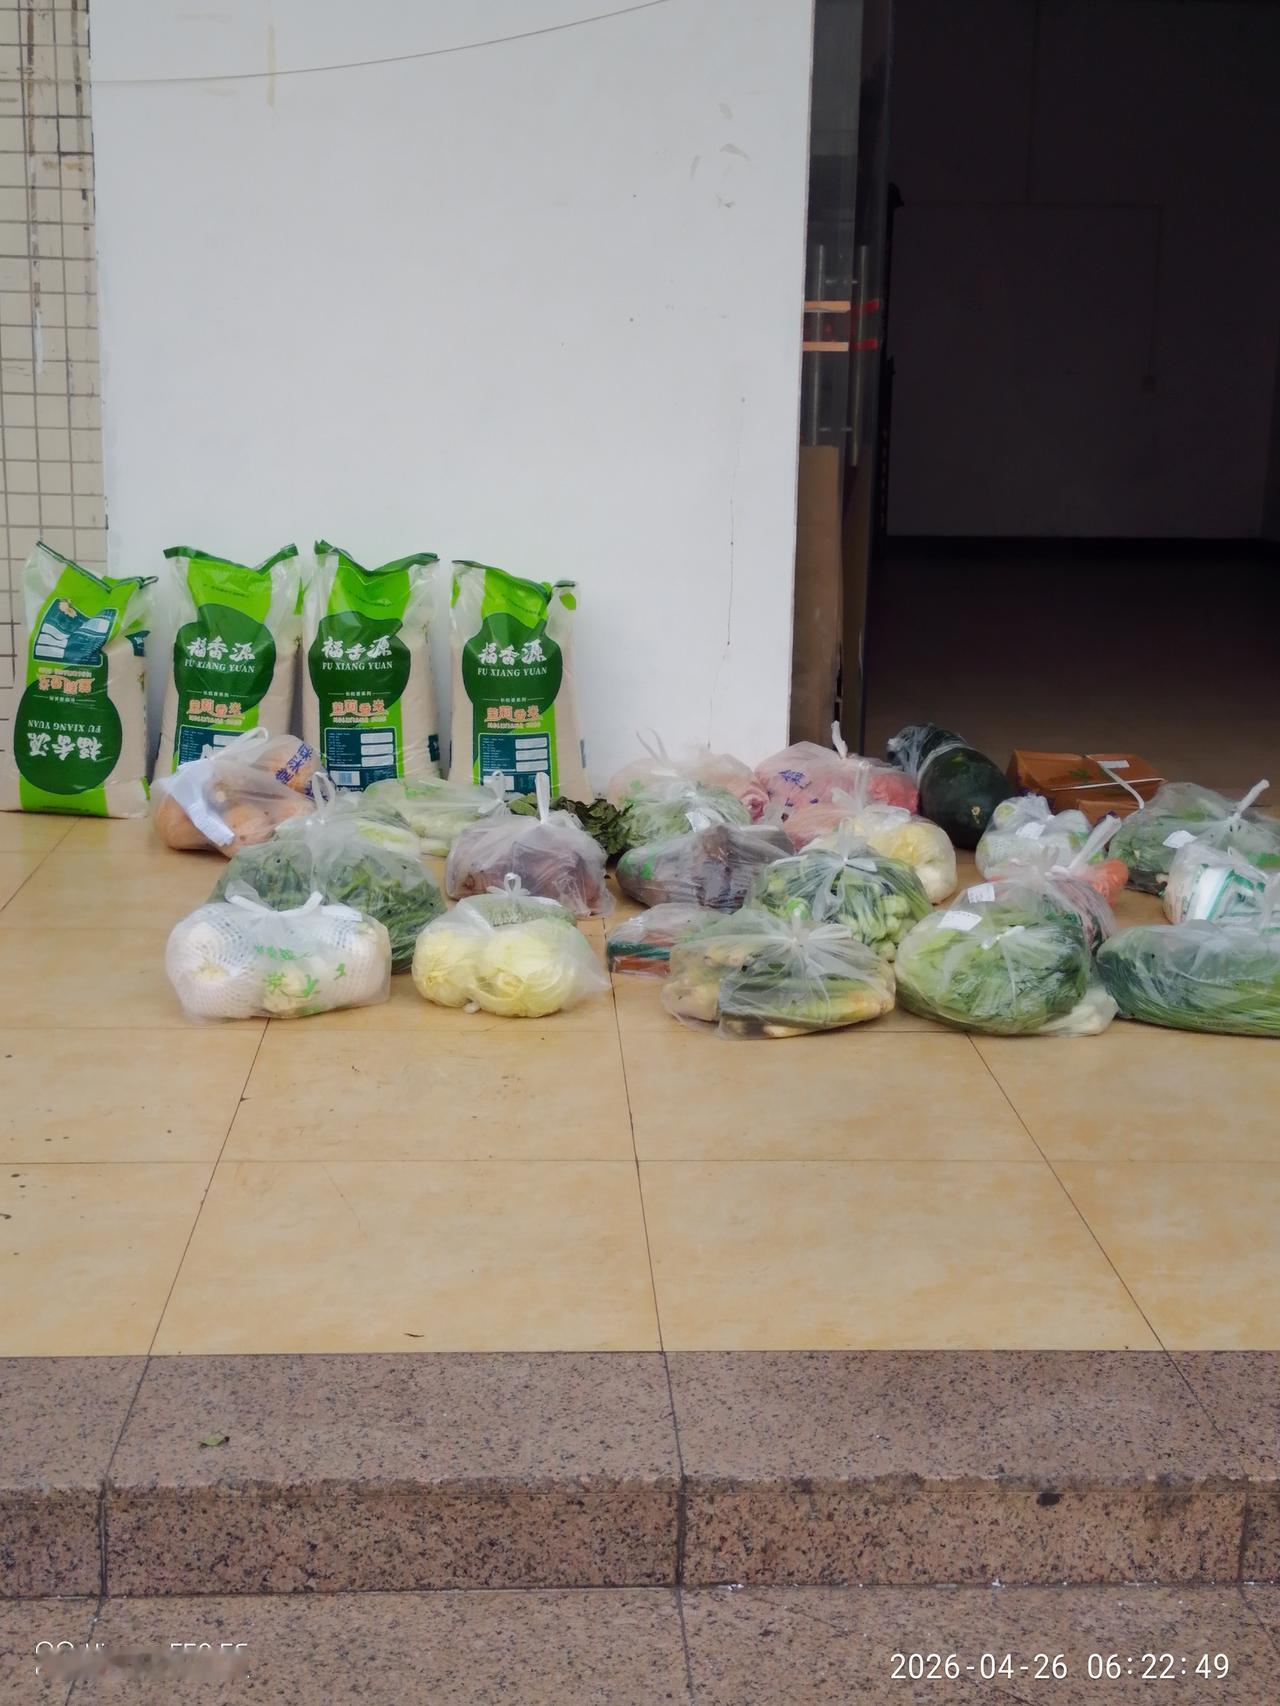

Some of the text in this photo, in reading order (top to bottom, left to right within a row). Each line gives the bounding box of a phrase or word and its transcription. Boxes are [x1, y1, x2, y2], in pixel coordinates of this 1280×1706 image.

[322, 660, 393, 671] FU XIANG YUAN
[477, 666, 548, 677] FU XIANG YUAN
[28, 719, 102, 734] FU XIANG YUAN
